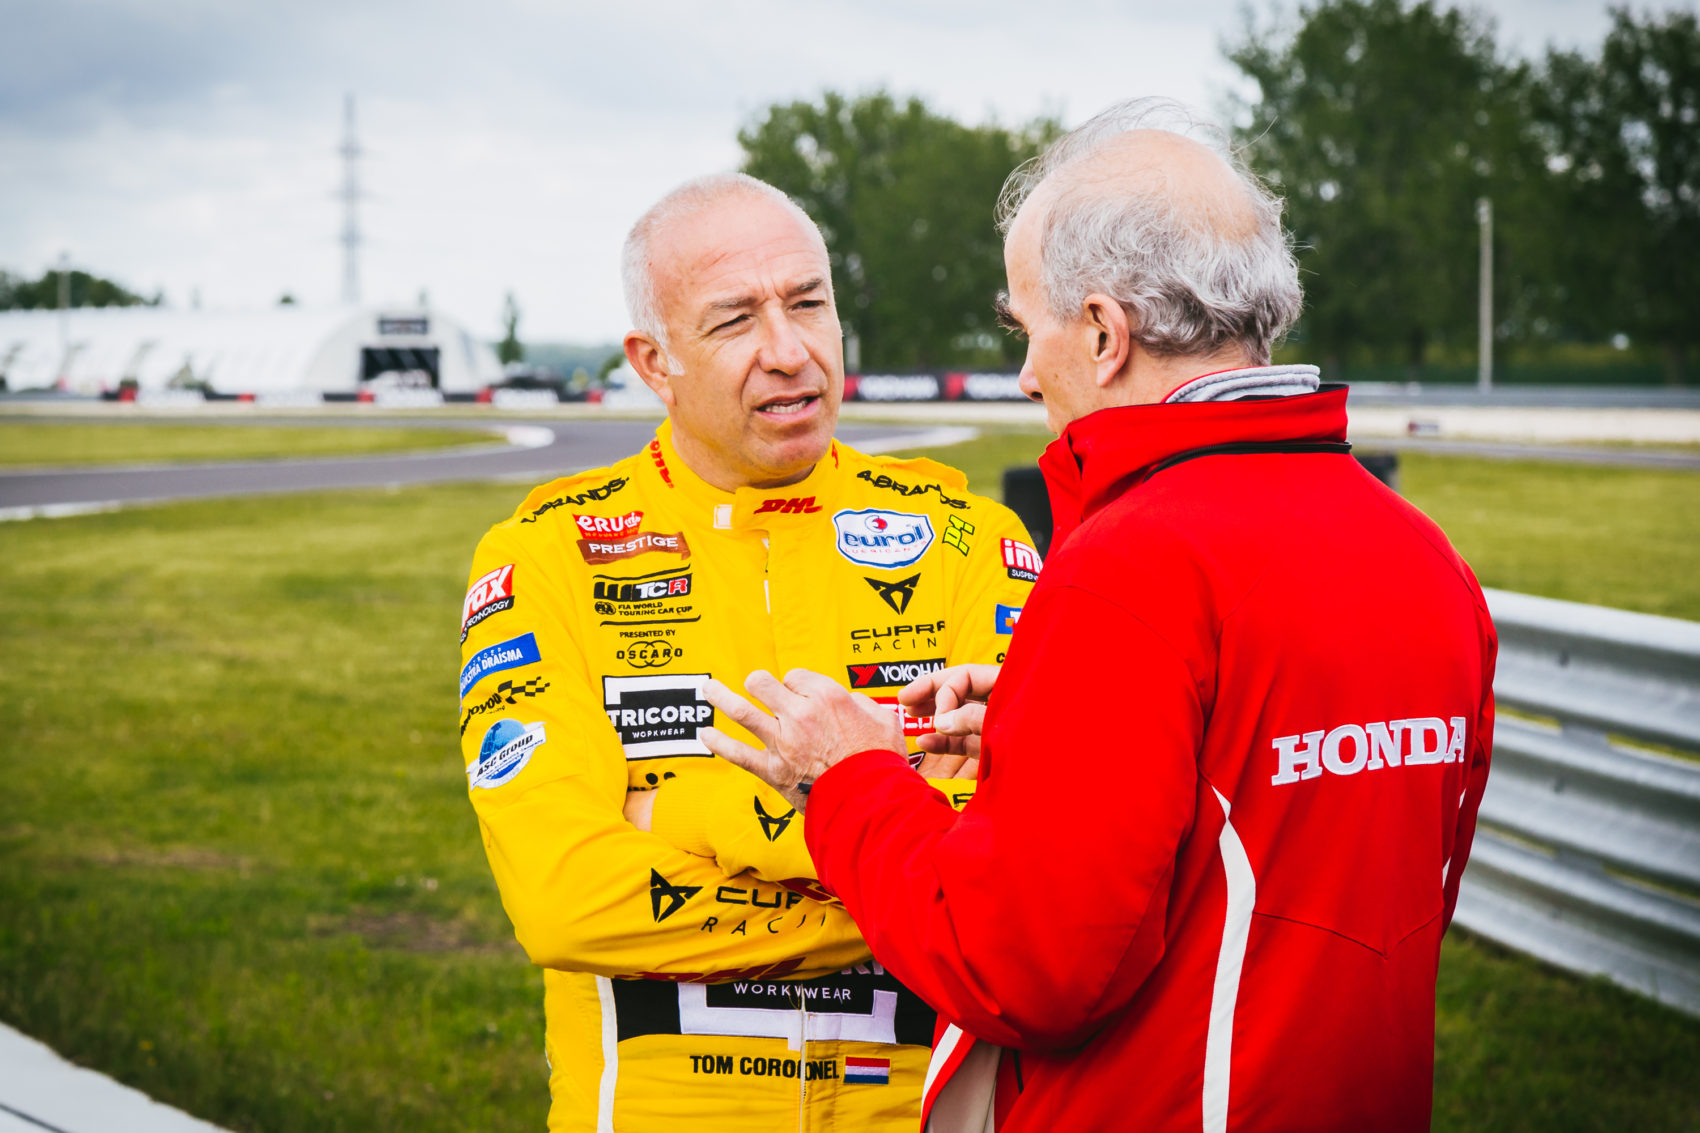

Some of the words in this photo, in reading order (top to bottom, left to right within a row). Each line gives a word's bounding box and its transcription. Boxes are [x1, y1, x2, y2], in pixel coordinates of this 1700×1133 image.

[753, 496, 823, 514] DHL
[589, 535, 679, 554] PRESTIGE
[843, 524, 925, 547] eurol
[594, 573, 692, 602] WTCR
[633, 602, 663, 610] WORLD
[657, 607, 674, 615] CAR
[676, 605, 693, 613] CUP
[620, 630, 664, 638] PRESENTED
[616, 648, 683, 660] OSCARO
[853, 637, 937, 653] RACIN
[481, 648, 523, 671] DRAISMA
[606, 705, 712, 727] TRICORP
[632, 728, 685, 738] WORKWEAR
[1271, 716, 1466, 786] HONDA
[689, 1055, 734, 1075] TOM
